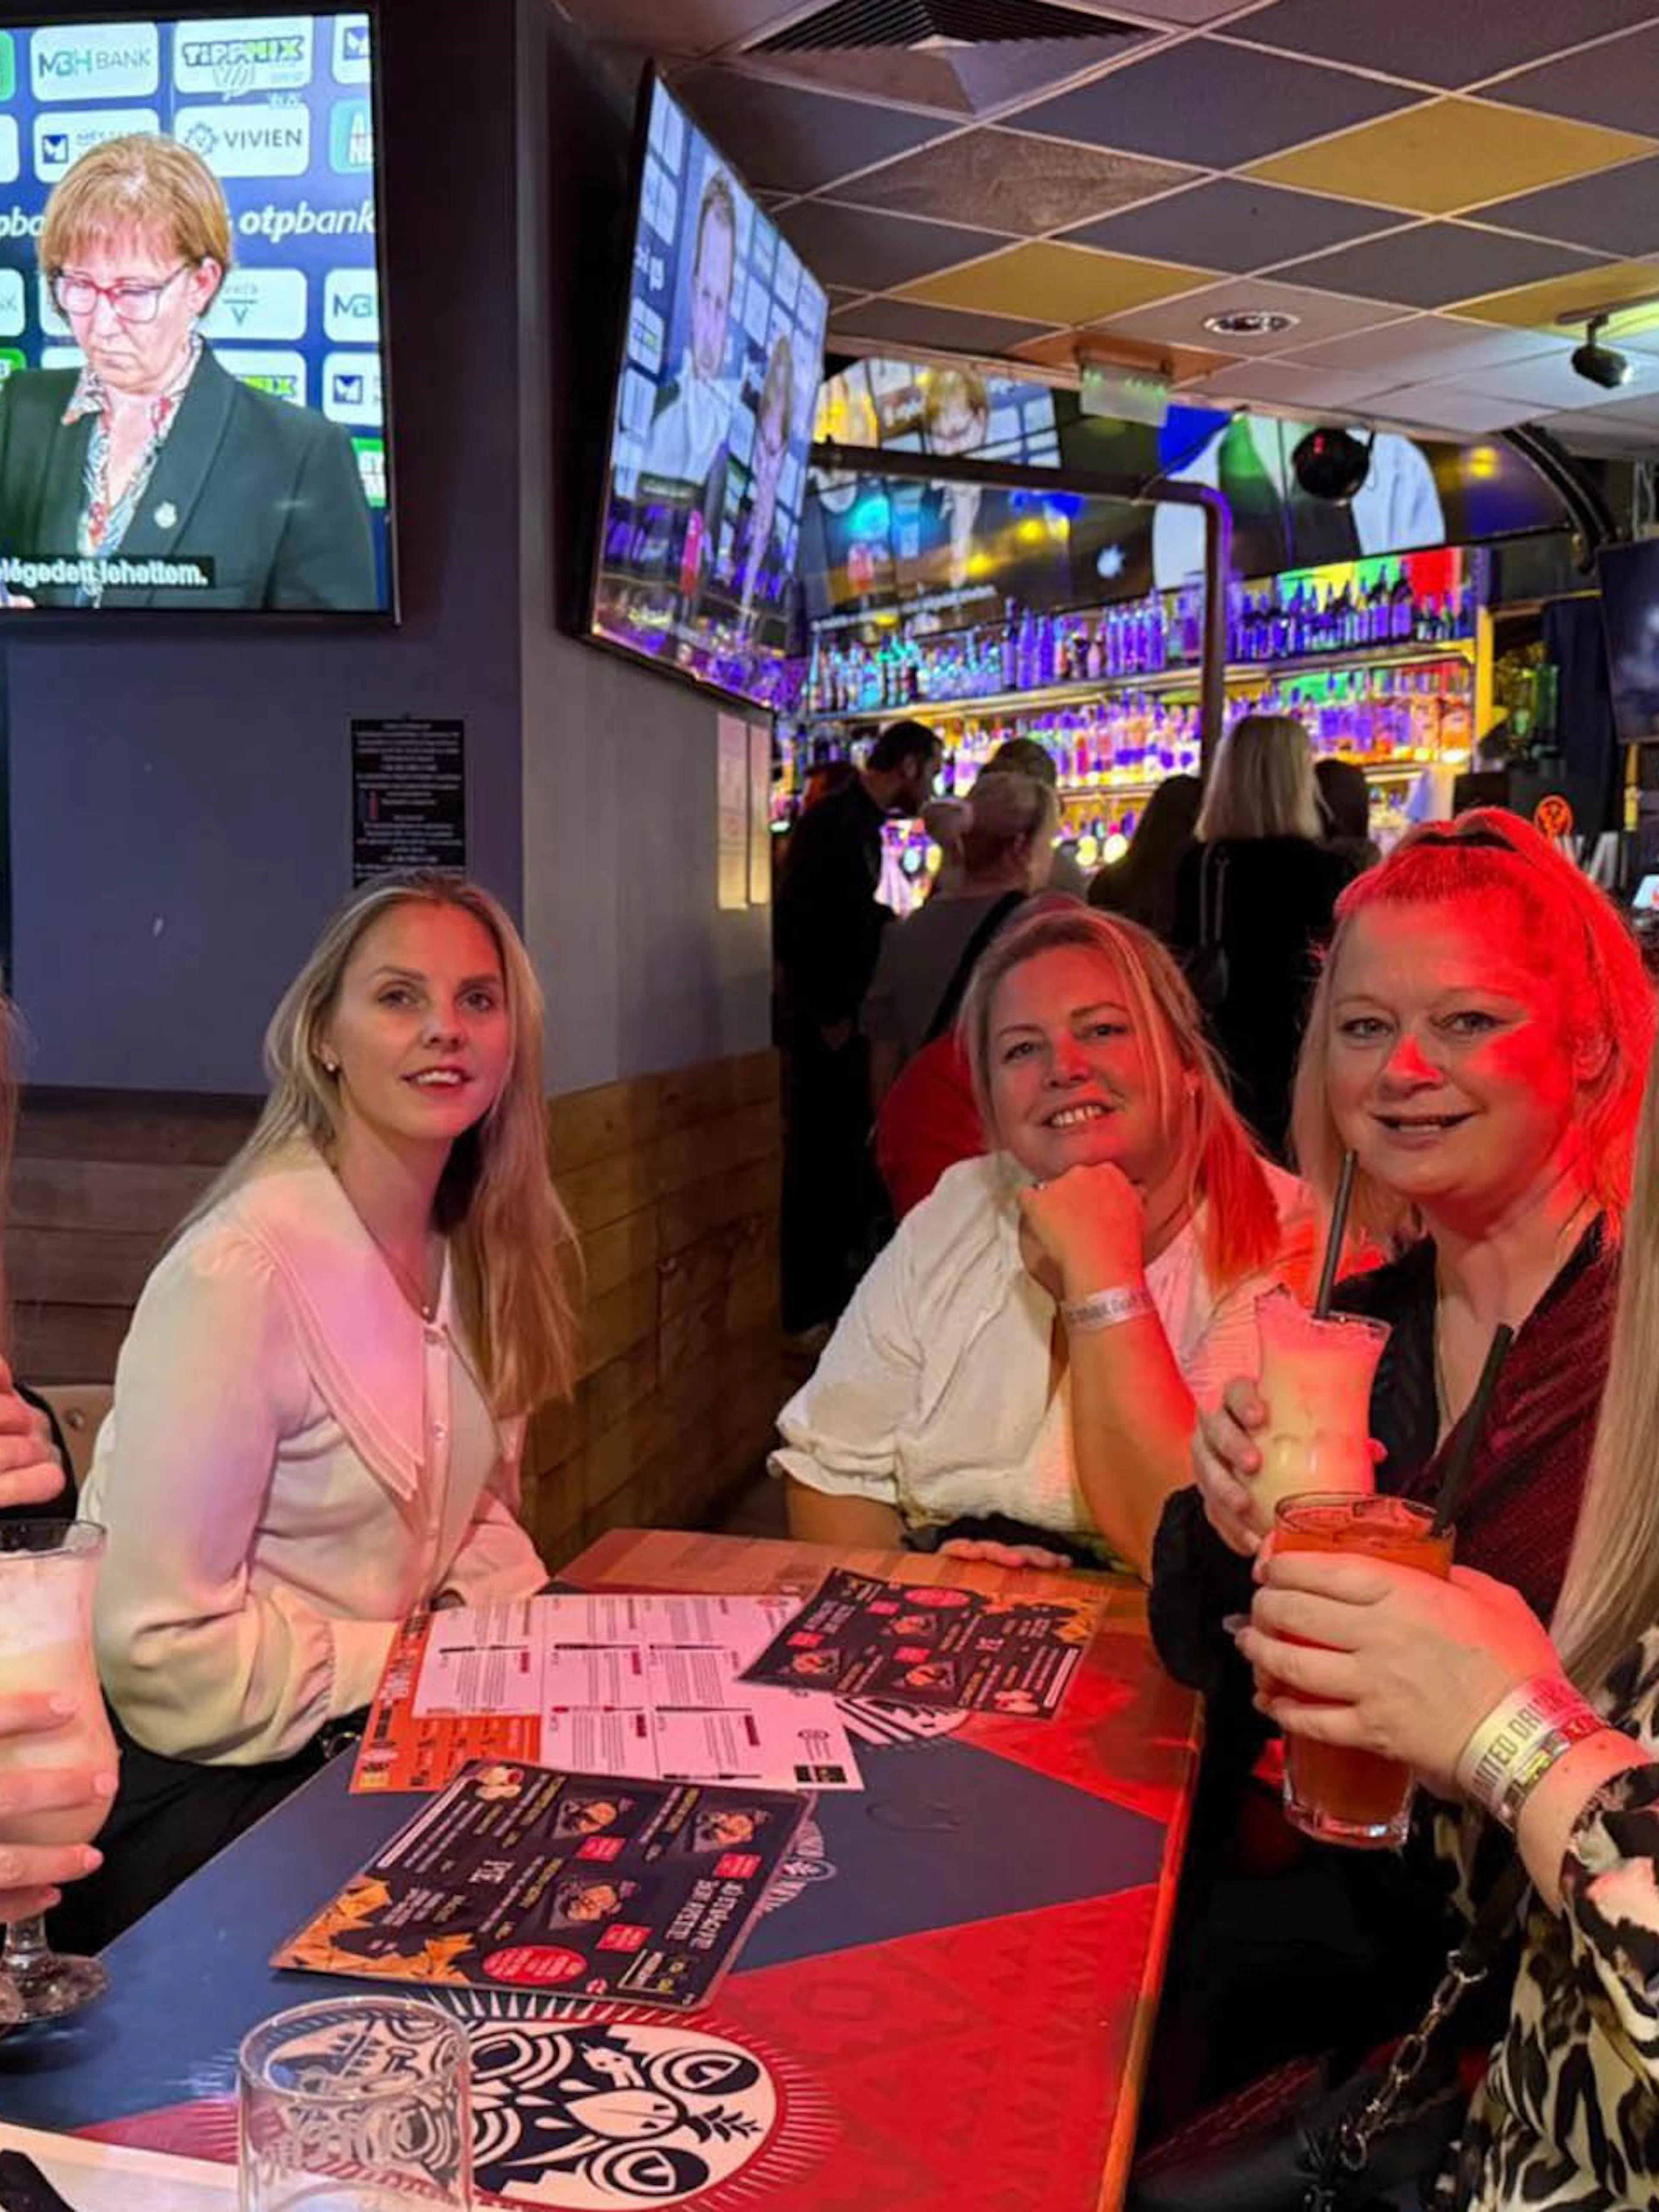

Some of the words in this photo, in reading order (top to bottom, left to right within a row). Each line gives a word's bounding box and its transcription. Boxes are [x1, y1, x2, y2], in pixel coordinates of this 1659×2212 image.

[38, 48, 92, 79] MBH
[95, 48, 152, 70] BANK
[223, 127, 302, 150] VIVIEN
[239, 200, 375, 243] otpbank
